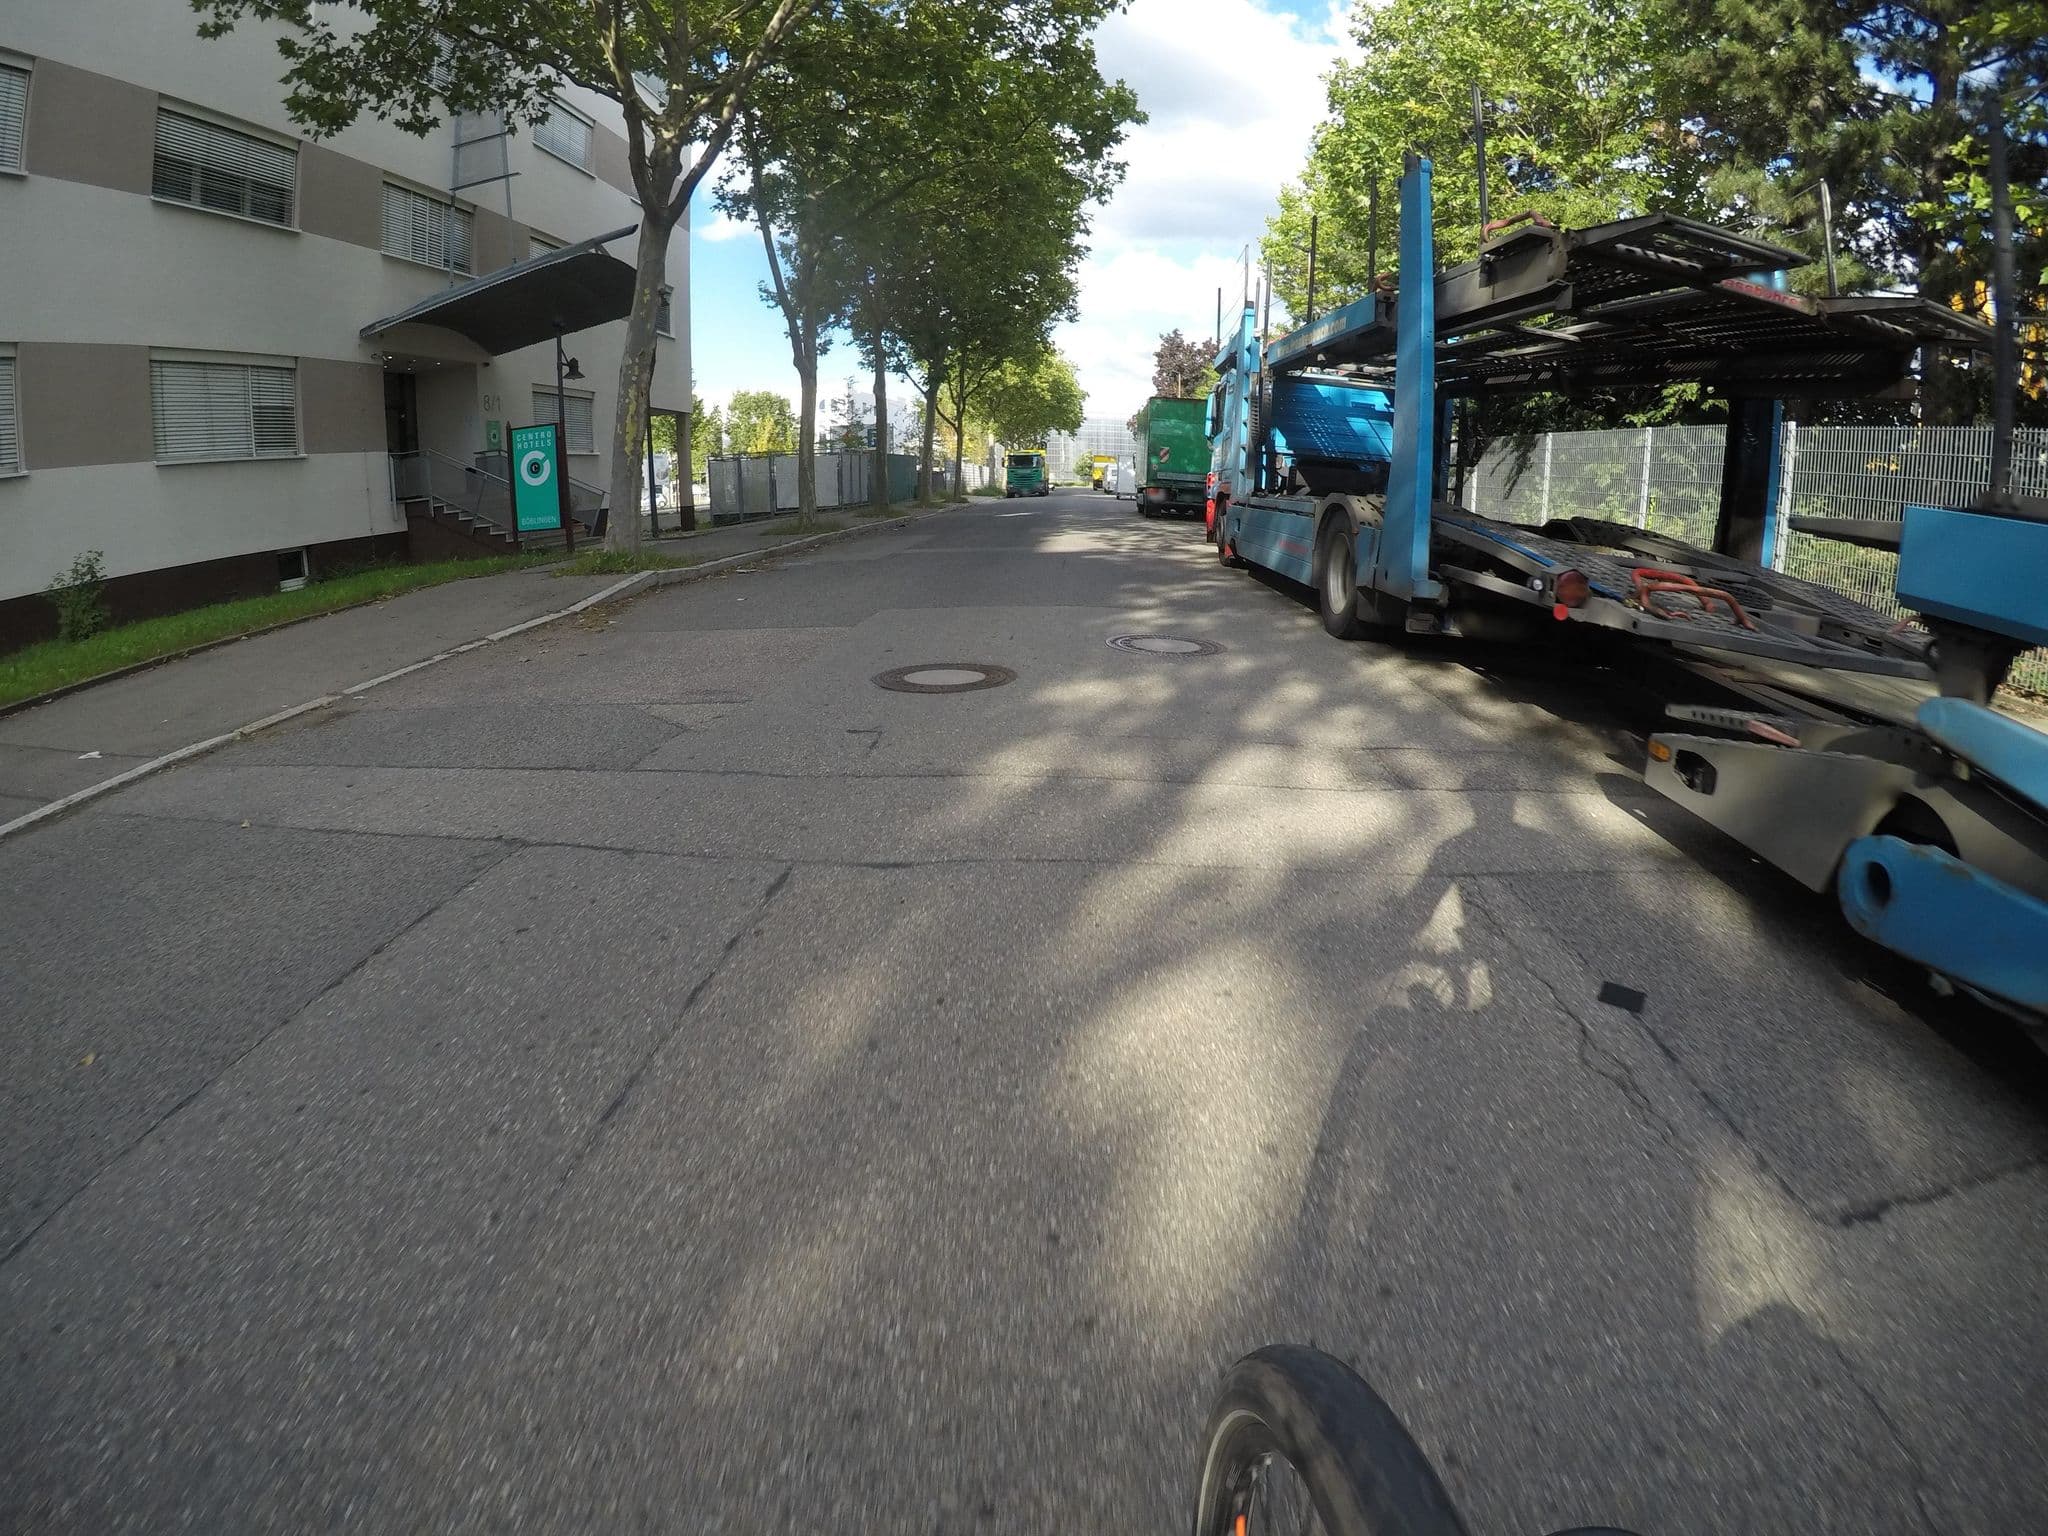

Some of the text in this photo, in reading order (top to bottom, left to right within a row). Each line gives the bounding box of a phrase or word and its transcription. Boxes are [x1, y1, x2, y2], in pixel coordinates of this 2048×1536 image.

[483, 394, 502, 412] 8/1
[516, 430, 552, 442] CENTRO
[517, 438, 552, 450] HOTELS
